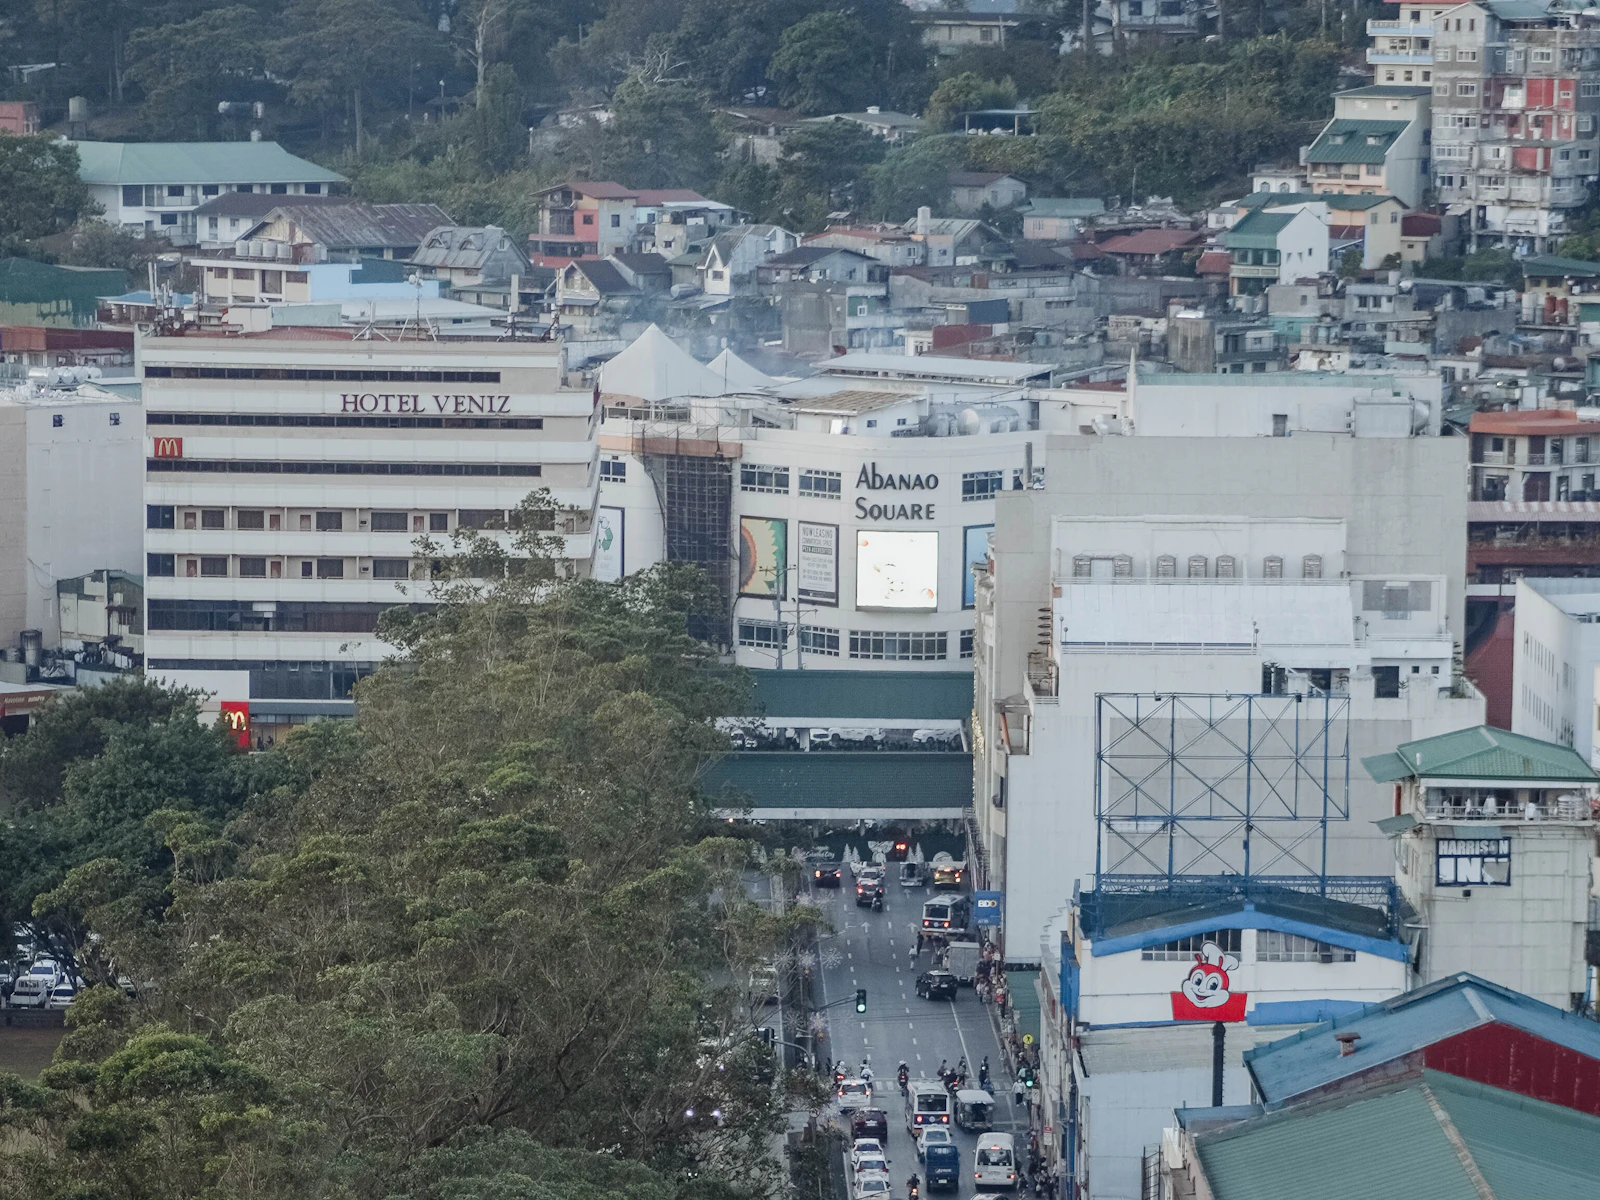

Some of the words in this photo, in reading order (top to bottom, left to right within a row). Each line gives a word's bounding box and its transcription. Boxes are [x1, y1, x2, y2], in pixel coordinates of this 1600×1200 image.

[340, 393, 426, 414] HOTEL
[432, 395, 512, 415] VENIZ
[855, 497, 935, 521] SQUARE
[803, 527, 813, 537] NOW
[814, 528, 833, 539] LEASING
[1439, 841, 1509, 855] HARRISON
